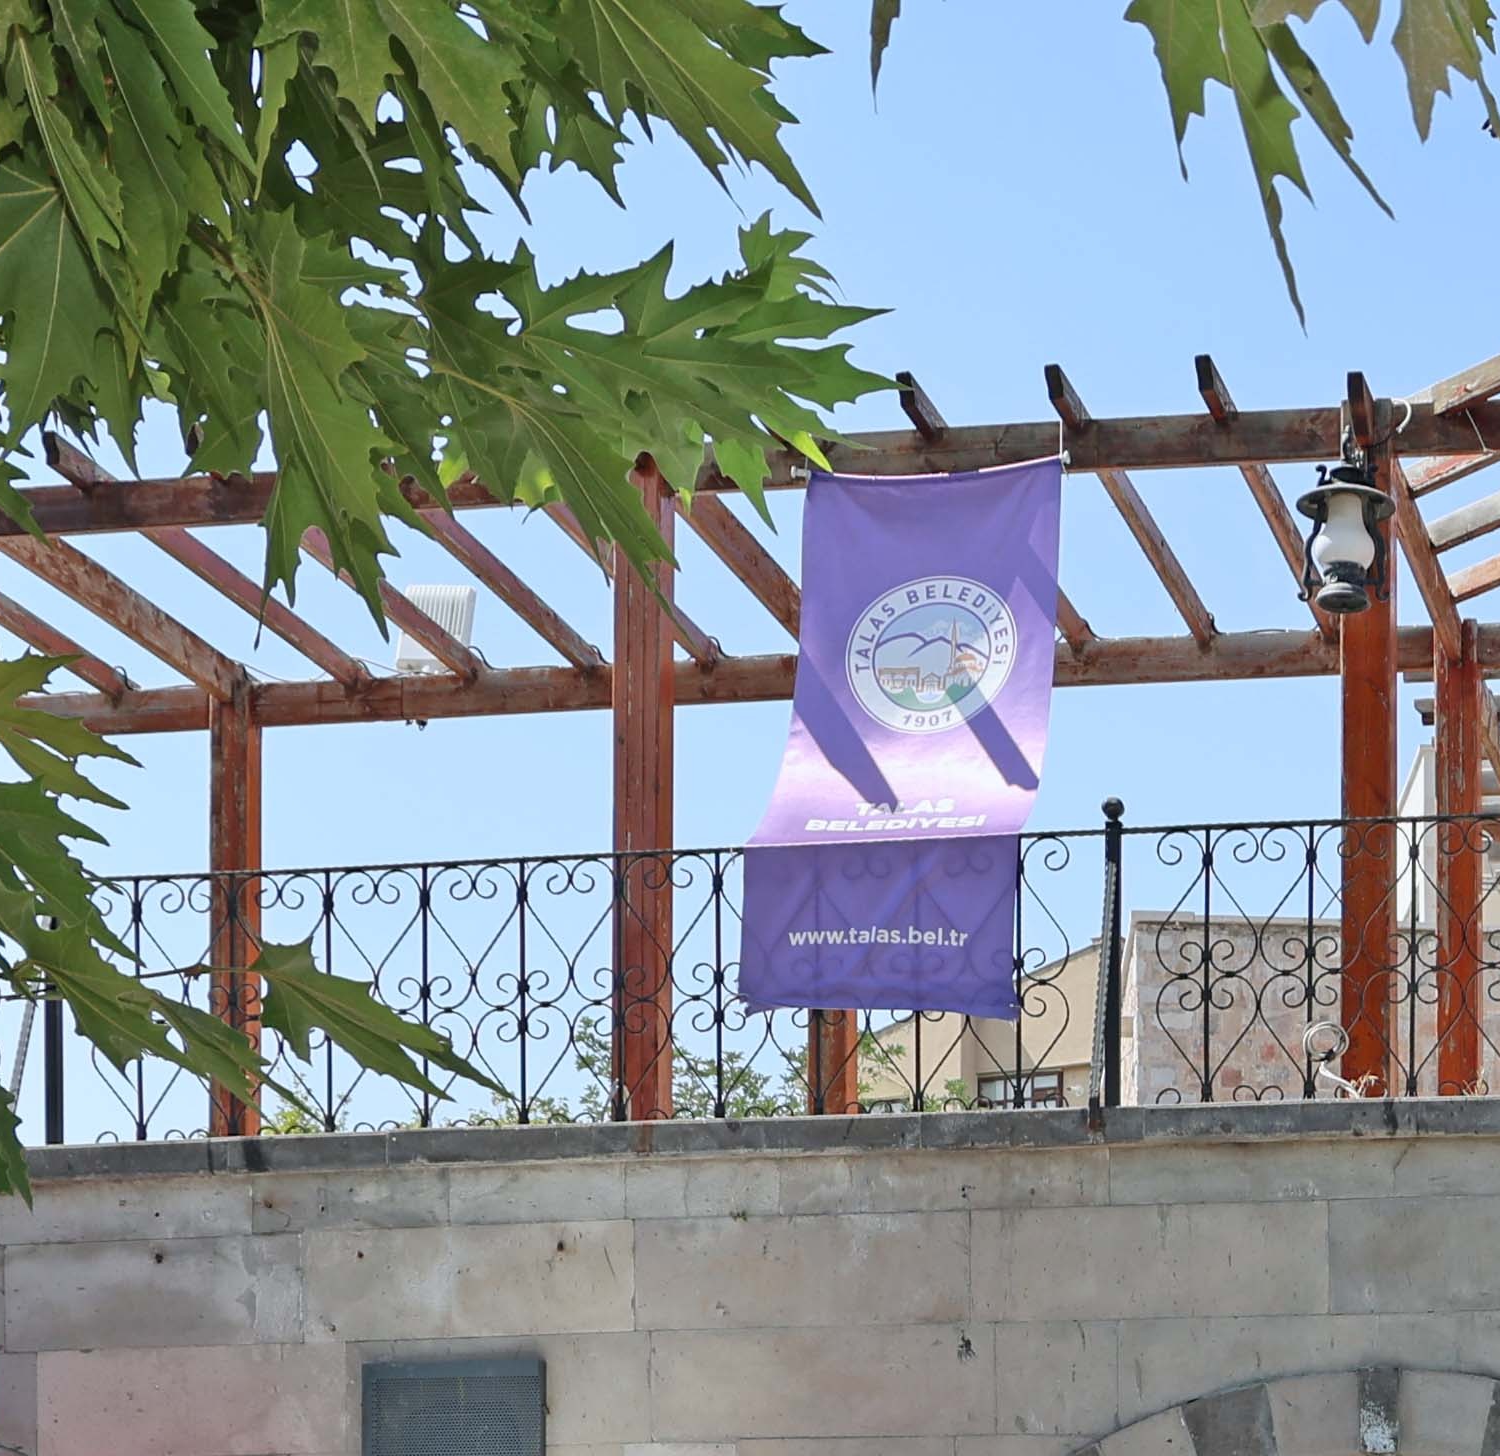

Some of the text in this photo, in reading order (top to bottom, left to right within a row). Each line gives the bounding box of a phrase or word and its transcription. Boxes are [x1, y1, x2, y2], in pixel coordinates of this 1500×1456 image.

[855, 583, 1009, 674] TALAS BELEDİYESİ
[902, 709, 954, 729] 1907
[855, 798, 956, 816] TALAS
[804, 814, 987, 832] BELEDİYESİ
[788, 925, 968, 948] www.talas.bel.tr
